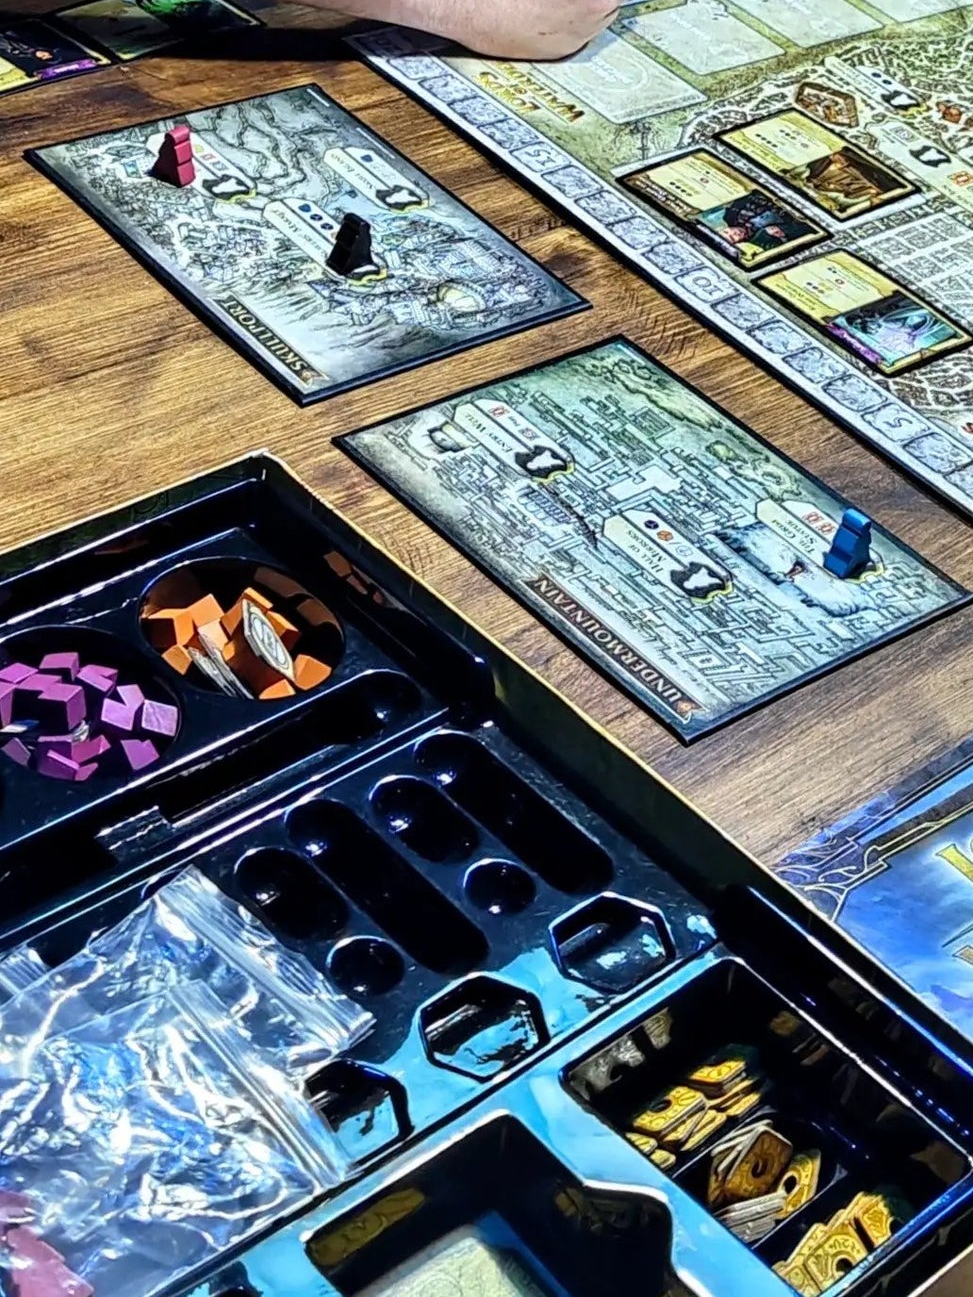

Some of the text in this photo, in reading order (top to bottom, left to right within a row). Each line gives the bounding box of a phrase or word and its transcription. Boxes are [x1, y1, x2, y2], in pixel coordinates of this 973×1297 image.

[525, 148, 556, 166] 15
[692, 276, 723, 296] 10
[220, 300, 308, 371] SKULLPORT
[534, 577, 683, 702] UNDERMOUNTAIN
